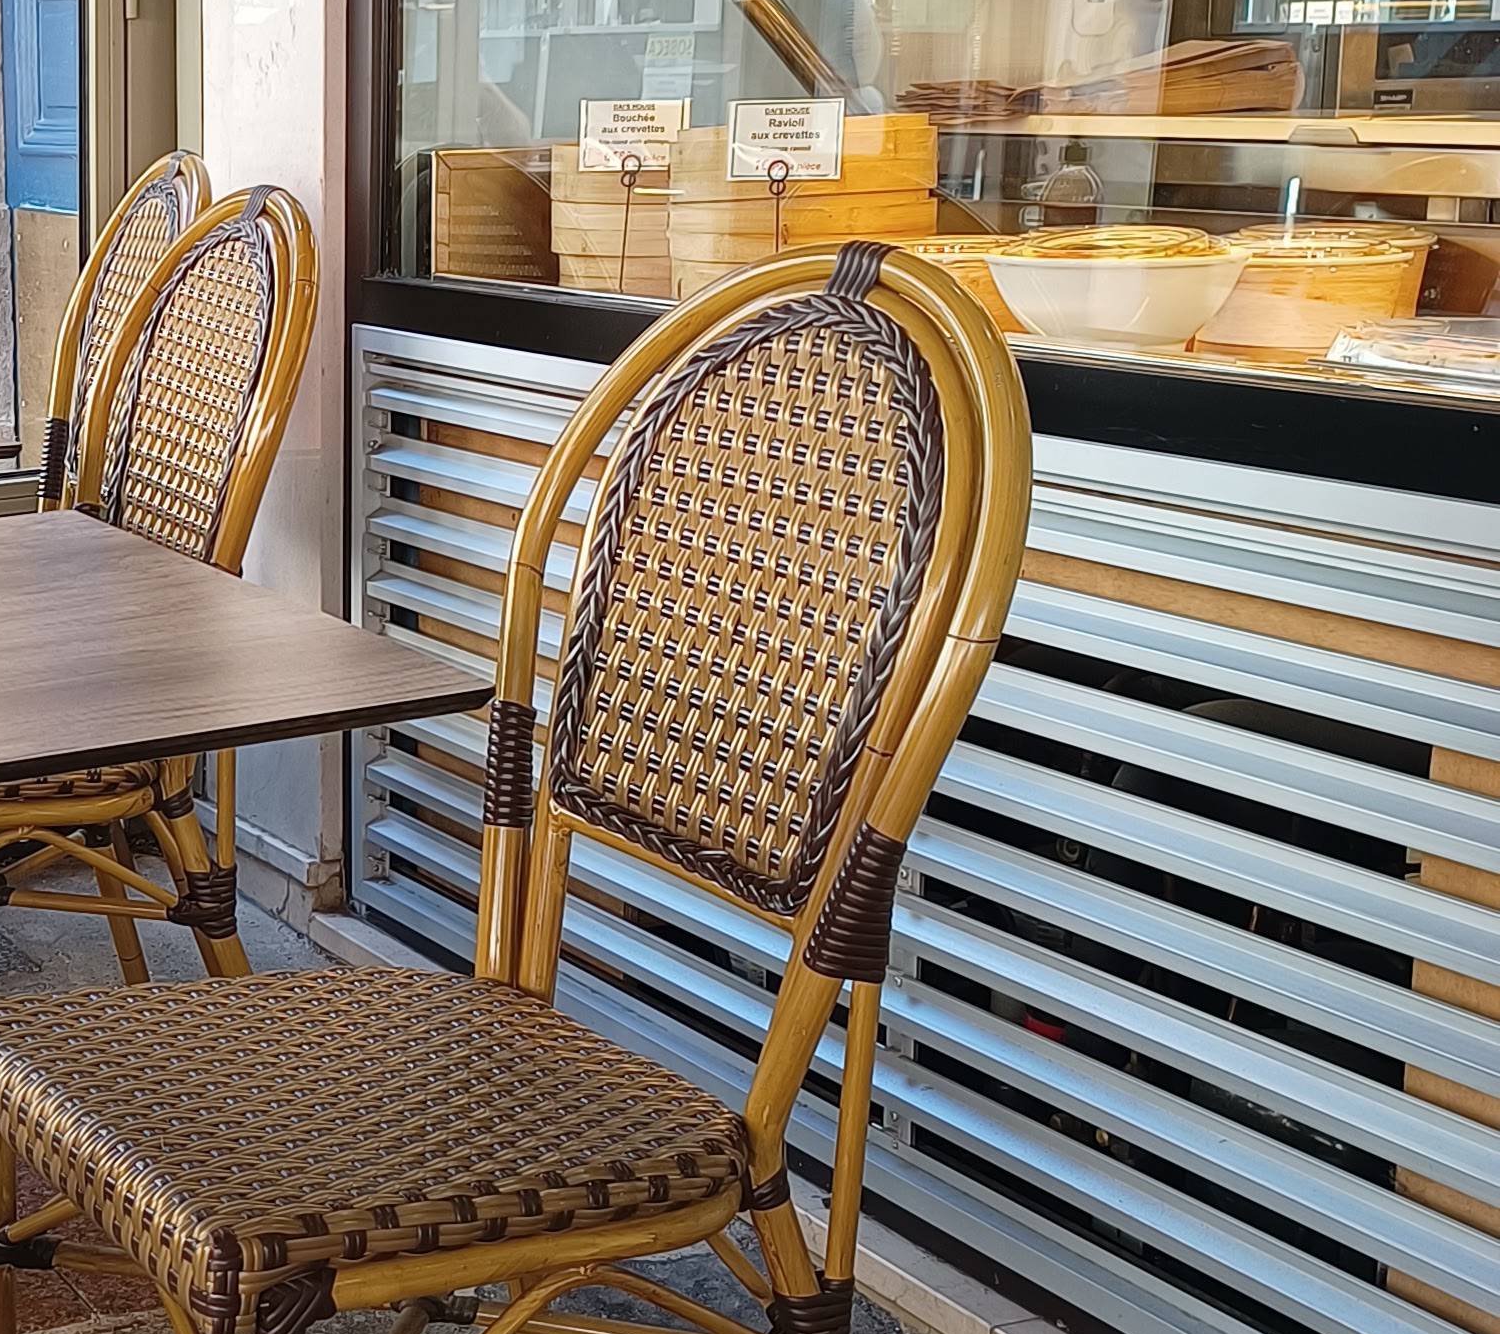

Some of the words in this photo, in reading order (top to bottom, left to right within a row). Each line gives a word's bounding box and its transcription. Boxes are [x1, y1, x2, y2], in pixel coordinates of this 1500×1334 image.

[613, 113, 655, 123] Bouchée
[768, 118, 805, 128] Ravioli
[621, 125, 665, 134] crevettes
[750, 132, 769, 140] aux
[772, 130, 820, 140] crevettes
